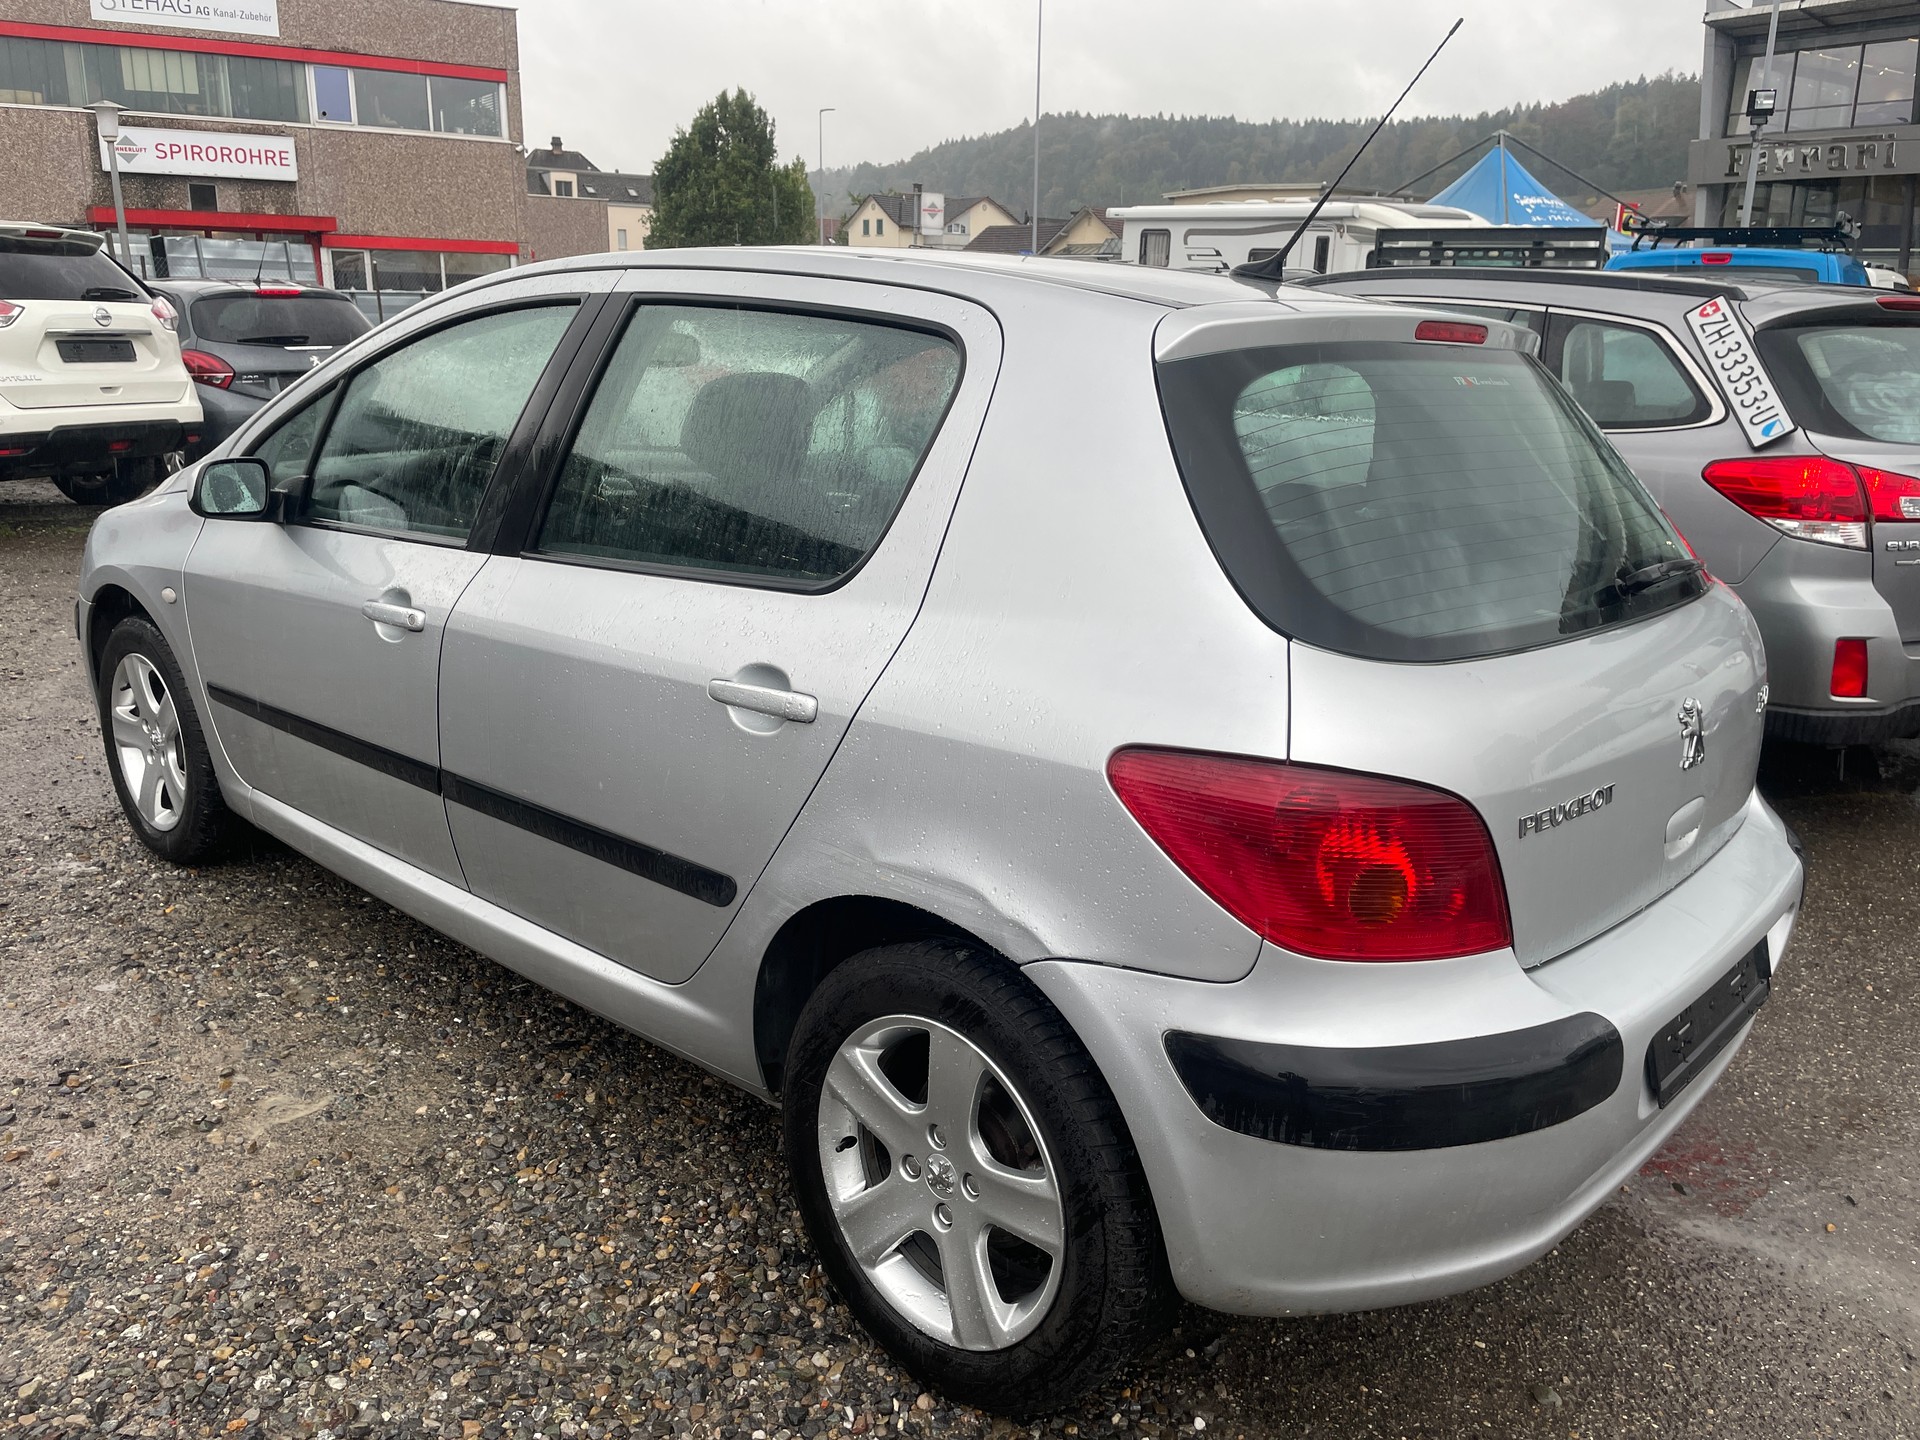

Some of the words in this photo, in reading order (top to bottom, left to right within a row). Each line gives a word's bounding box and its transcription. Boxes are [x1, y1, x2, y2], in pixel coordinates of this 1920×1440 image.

[195, 6, 210, 16] AG
[213, 7, 272, 22] Kanal-Zubehör
[154, 142, 291, 167] SPIROROHRE
[1518, 782, 1616, 839] PEUGEOT
